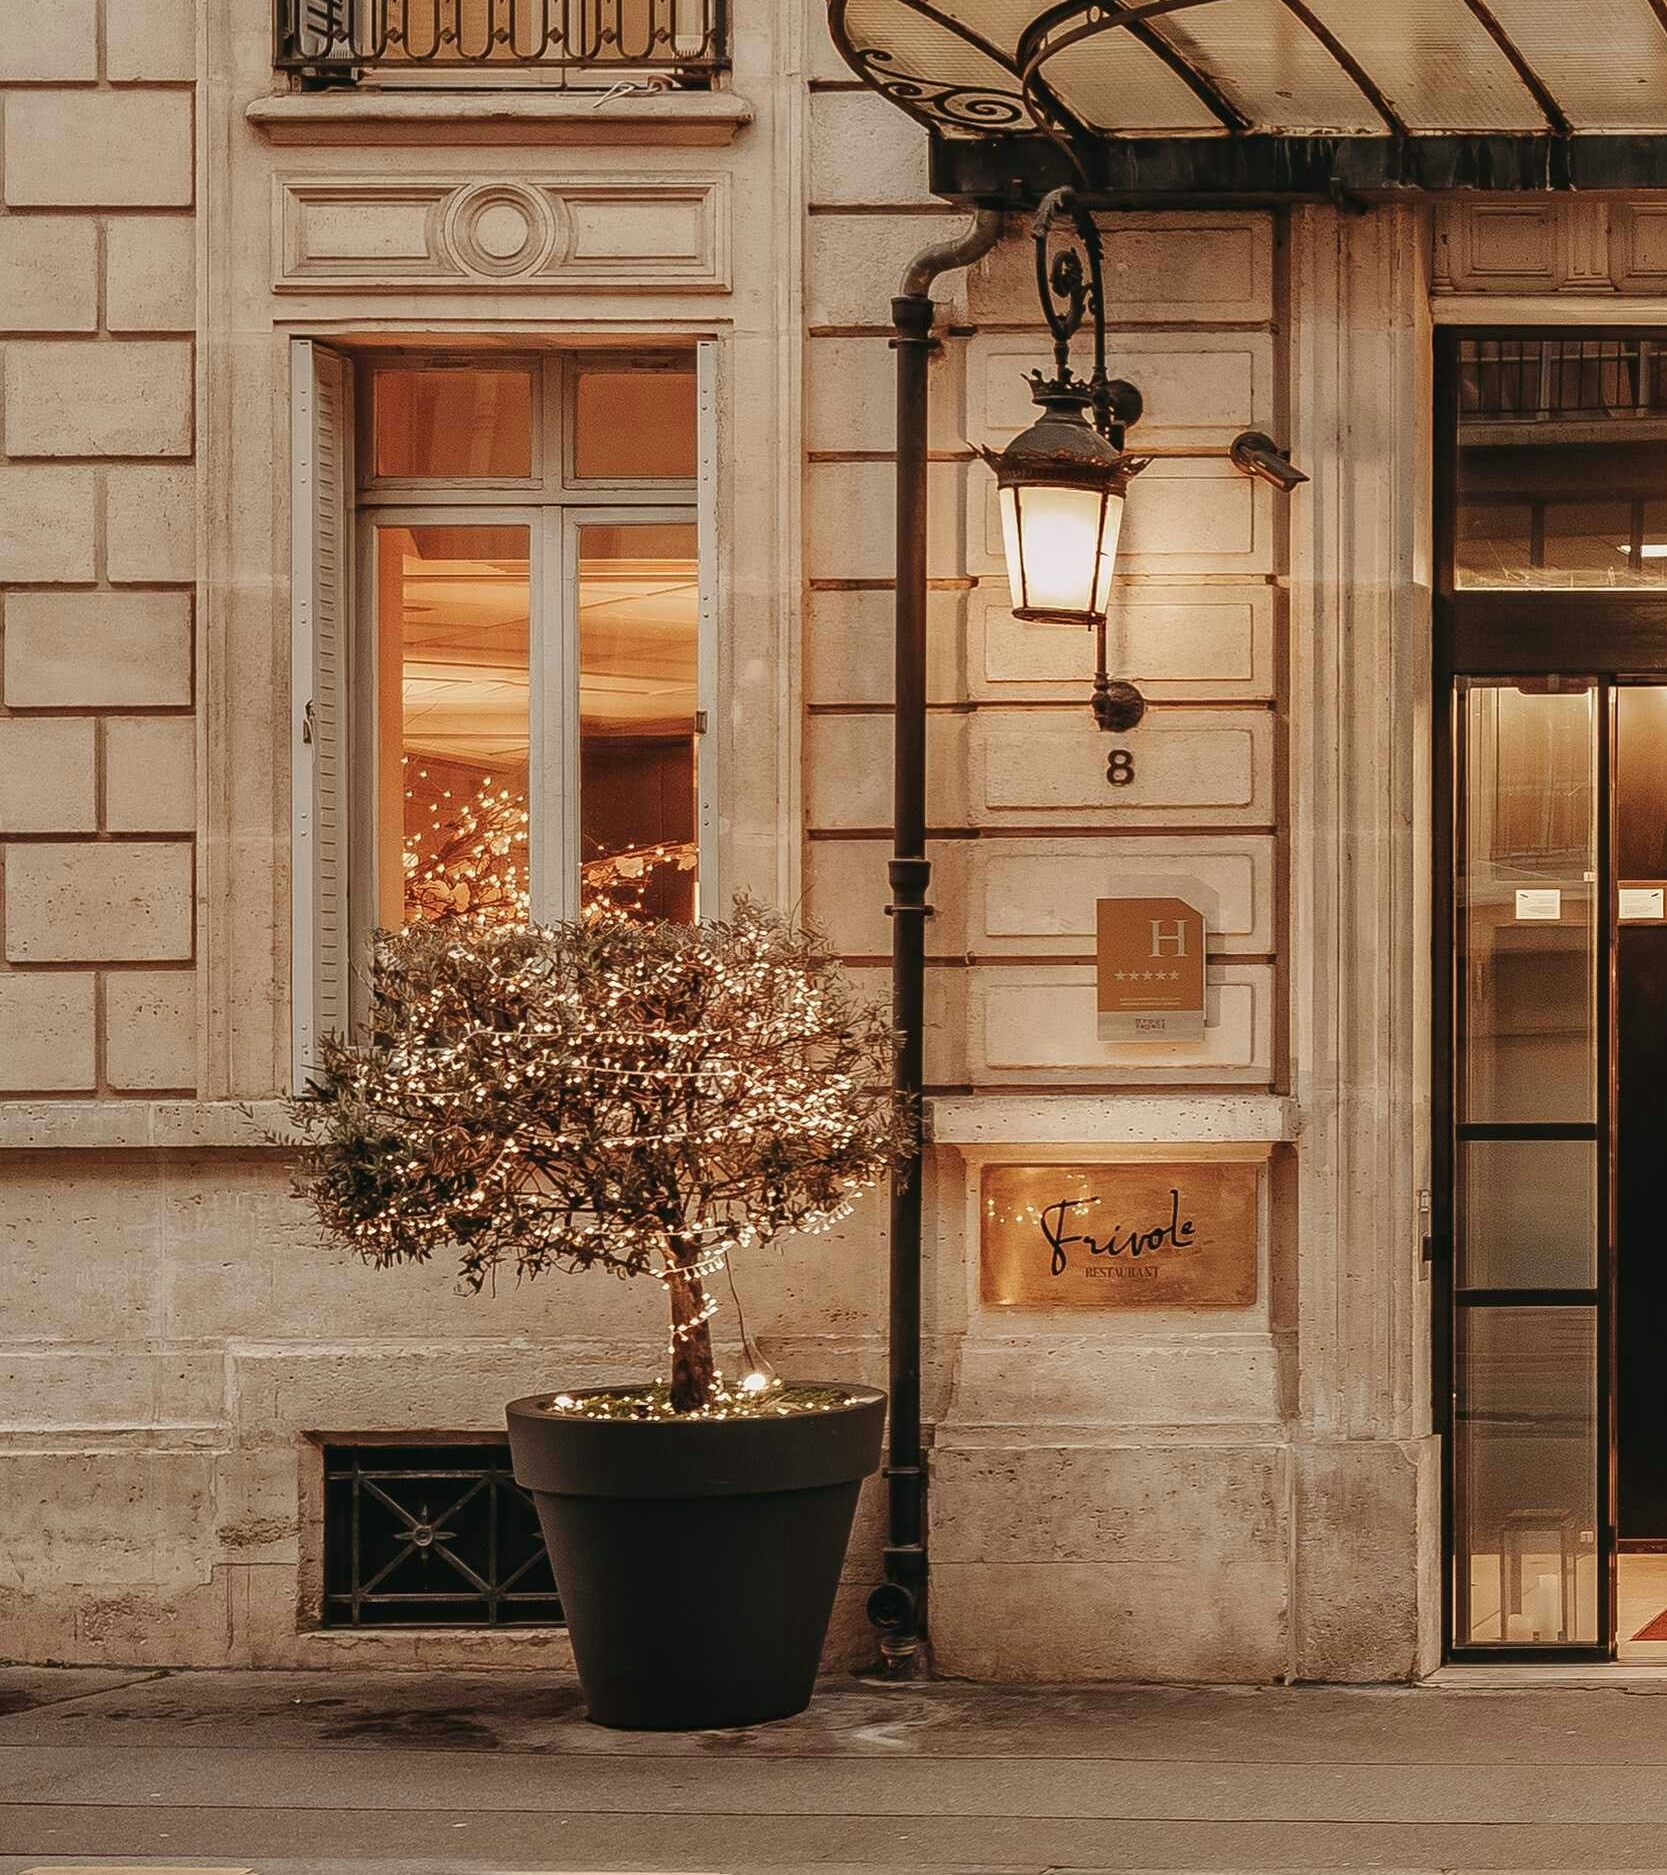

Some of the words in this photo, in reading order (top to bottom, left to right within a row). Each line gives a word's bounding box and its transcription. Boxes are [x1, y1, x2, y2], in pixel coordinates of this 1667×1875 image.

[1106, 749, 1135, 787] 8
[1148, 919, 1190, 958] H
[1040, 1188, 1196, 1276] Frivole
[1085, 1266, 1160, 1278] RESTAURANT
